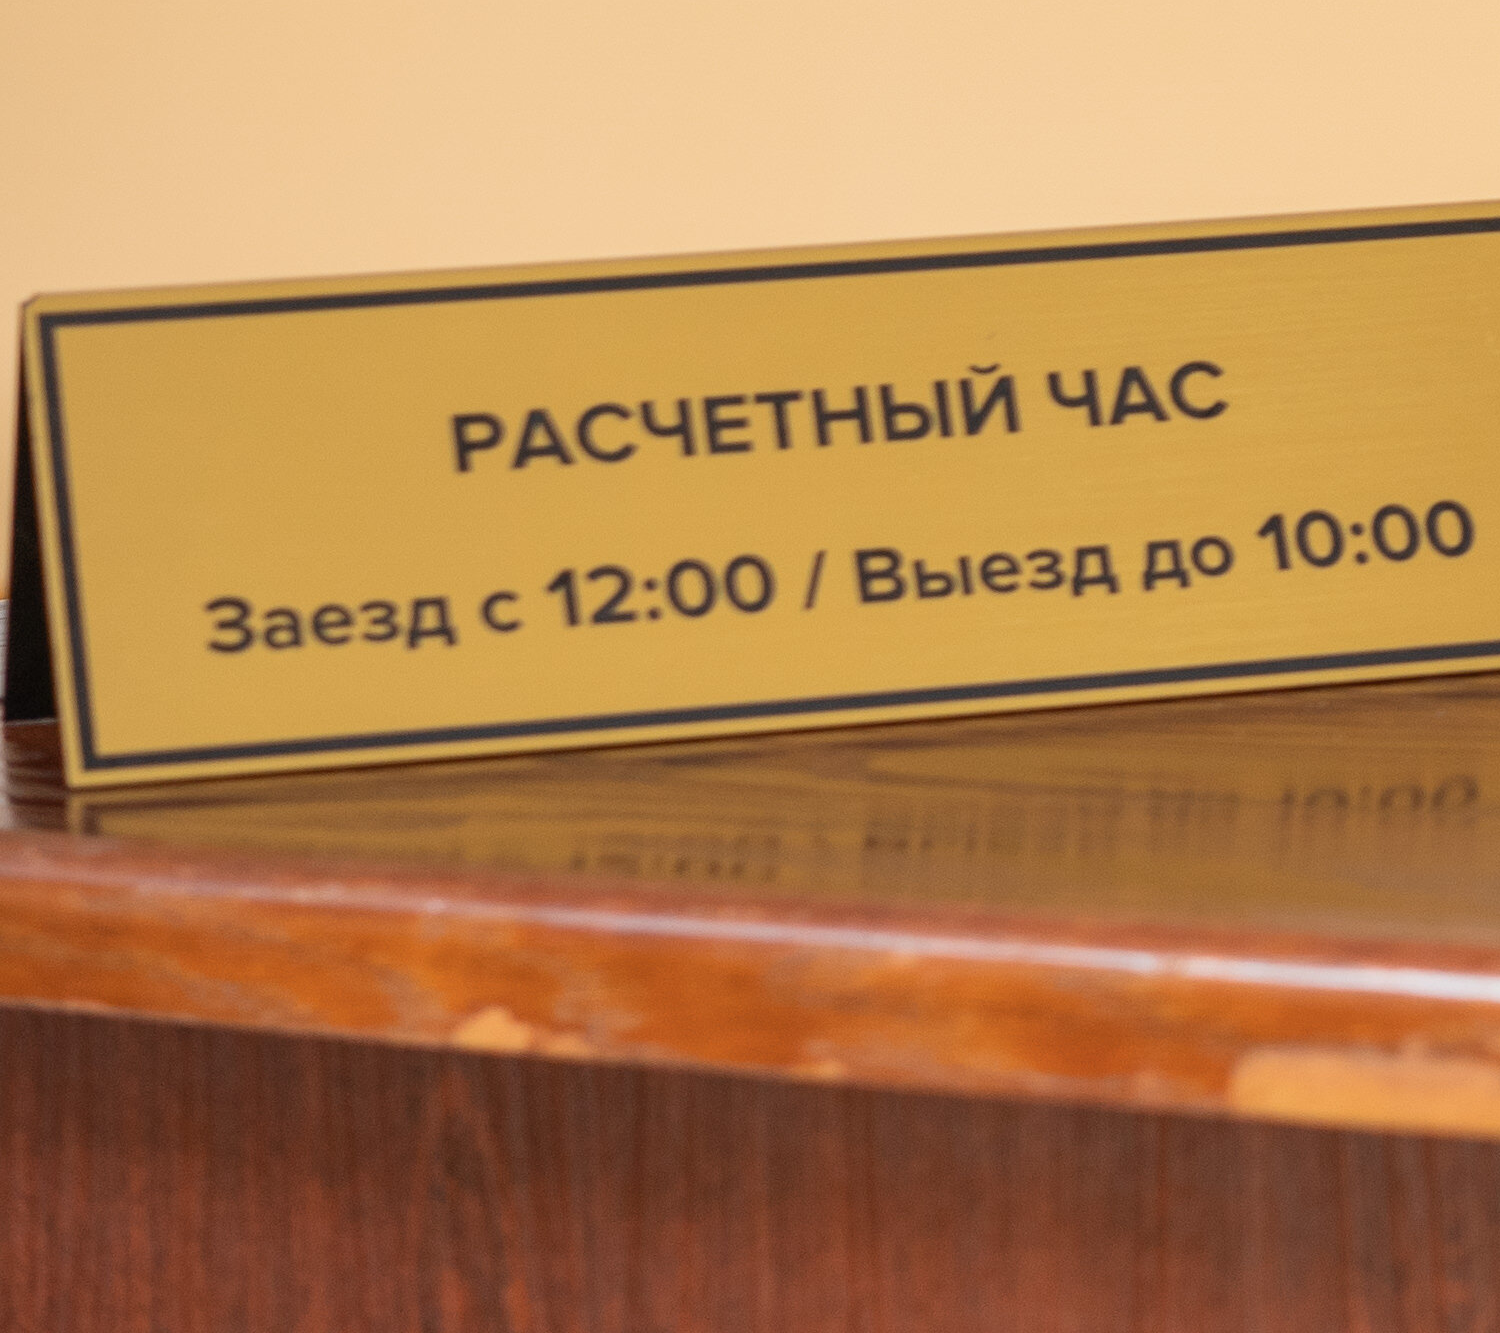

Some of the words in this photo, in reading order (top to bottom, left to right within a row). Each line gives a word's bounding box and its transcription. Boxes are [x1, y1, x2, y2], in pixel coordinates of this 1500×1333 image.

[452, 364, 1020, 473] РАСЧЕТНЫЙ
[1048, 360, 1228, 427] ЧАС
[205, 596, 457, 654] Заезд
[481, 591, 519, 633] с
[547, 555, 775, 627] 12:00
[805, 551, 825, 609] /
[854, 545, 1119, 604] Выезд
[1142, 536, 1234, 592] до
[1257, 500, 1475, 570] 10:00
